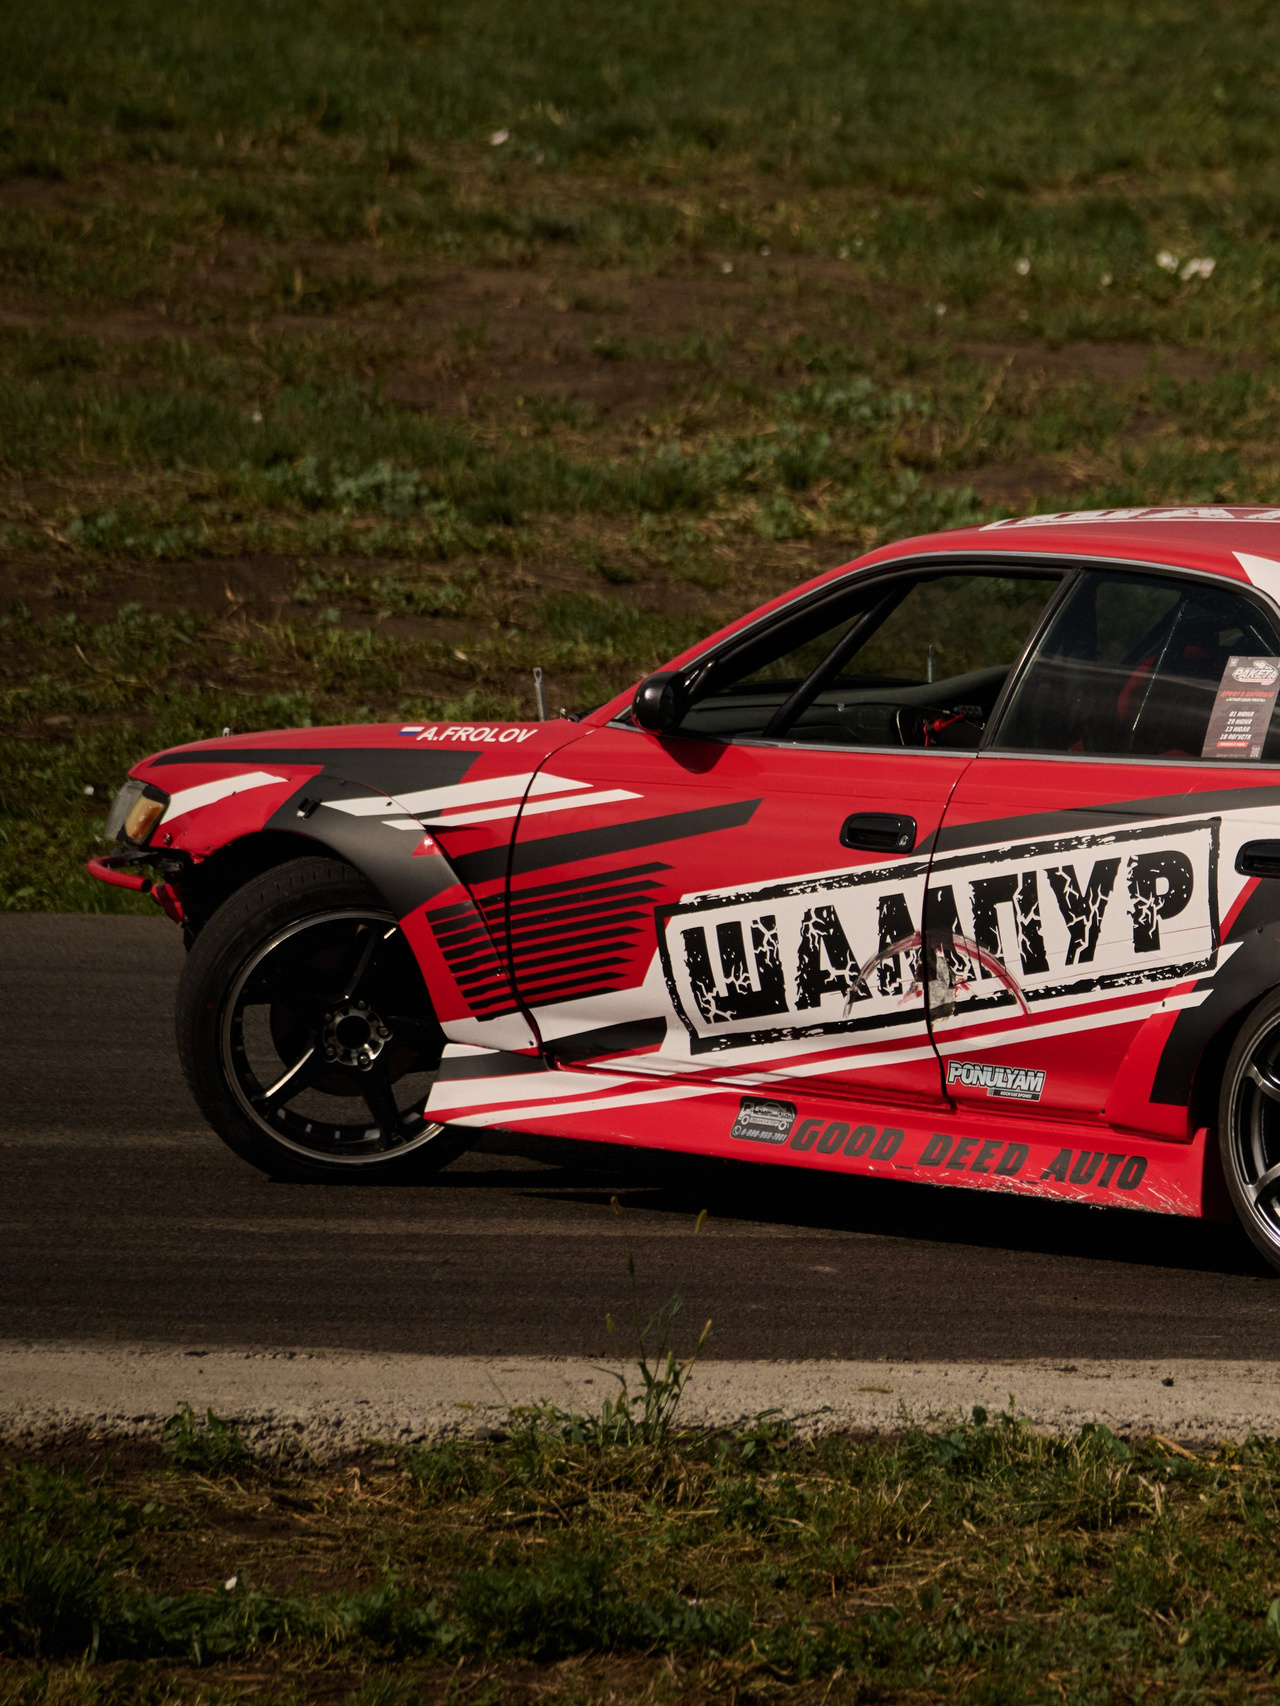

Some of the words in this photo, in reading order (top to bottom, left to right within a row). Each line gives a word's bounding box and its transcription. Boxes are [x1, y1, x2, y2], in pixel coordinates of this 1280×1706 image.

[416, 726, 538, 743] A.FROLOV
[680, 849, 1194, 1025] ШАМПУР
[948, 1061, 1045, 1092] PONULYAM
